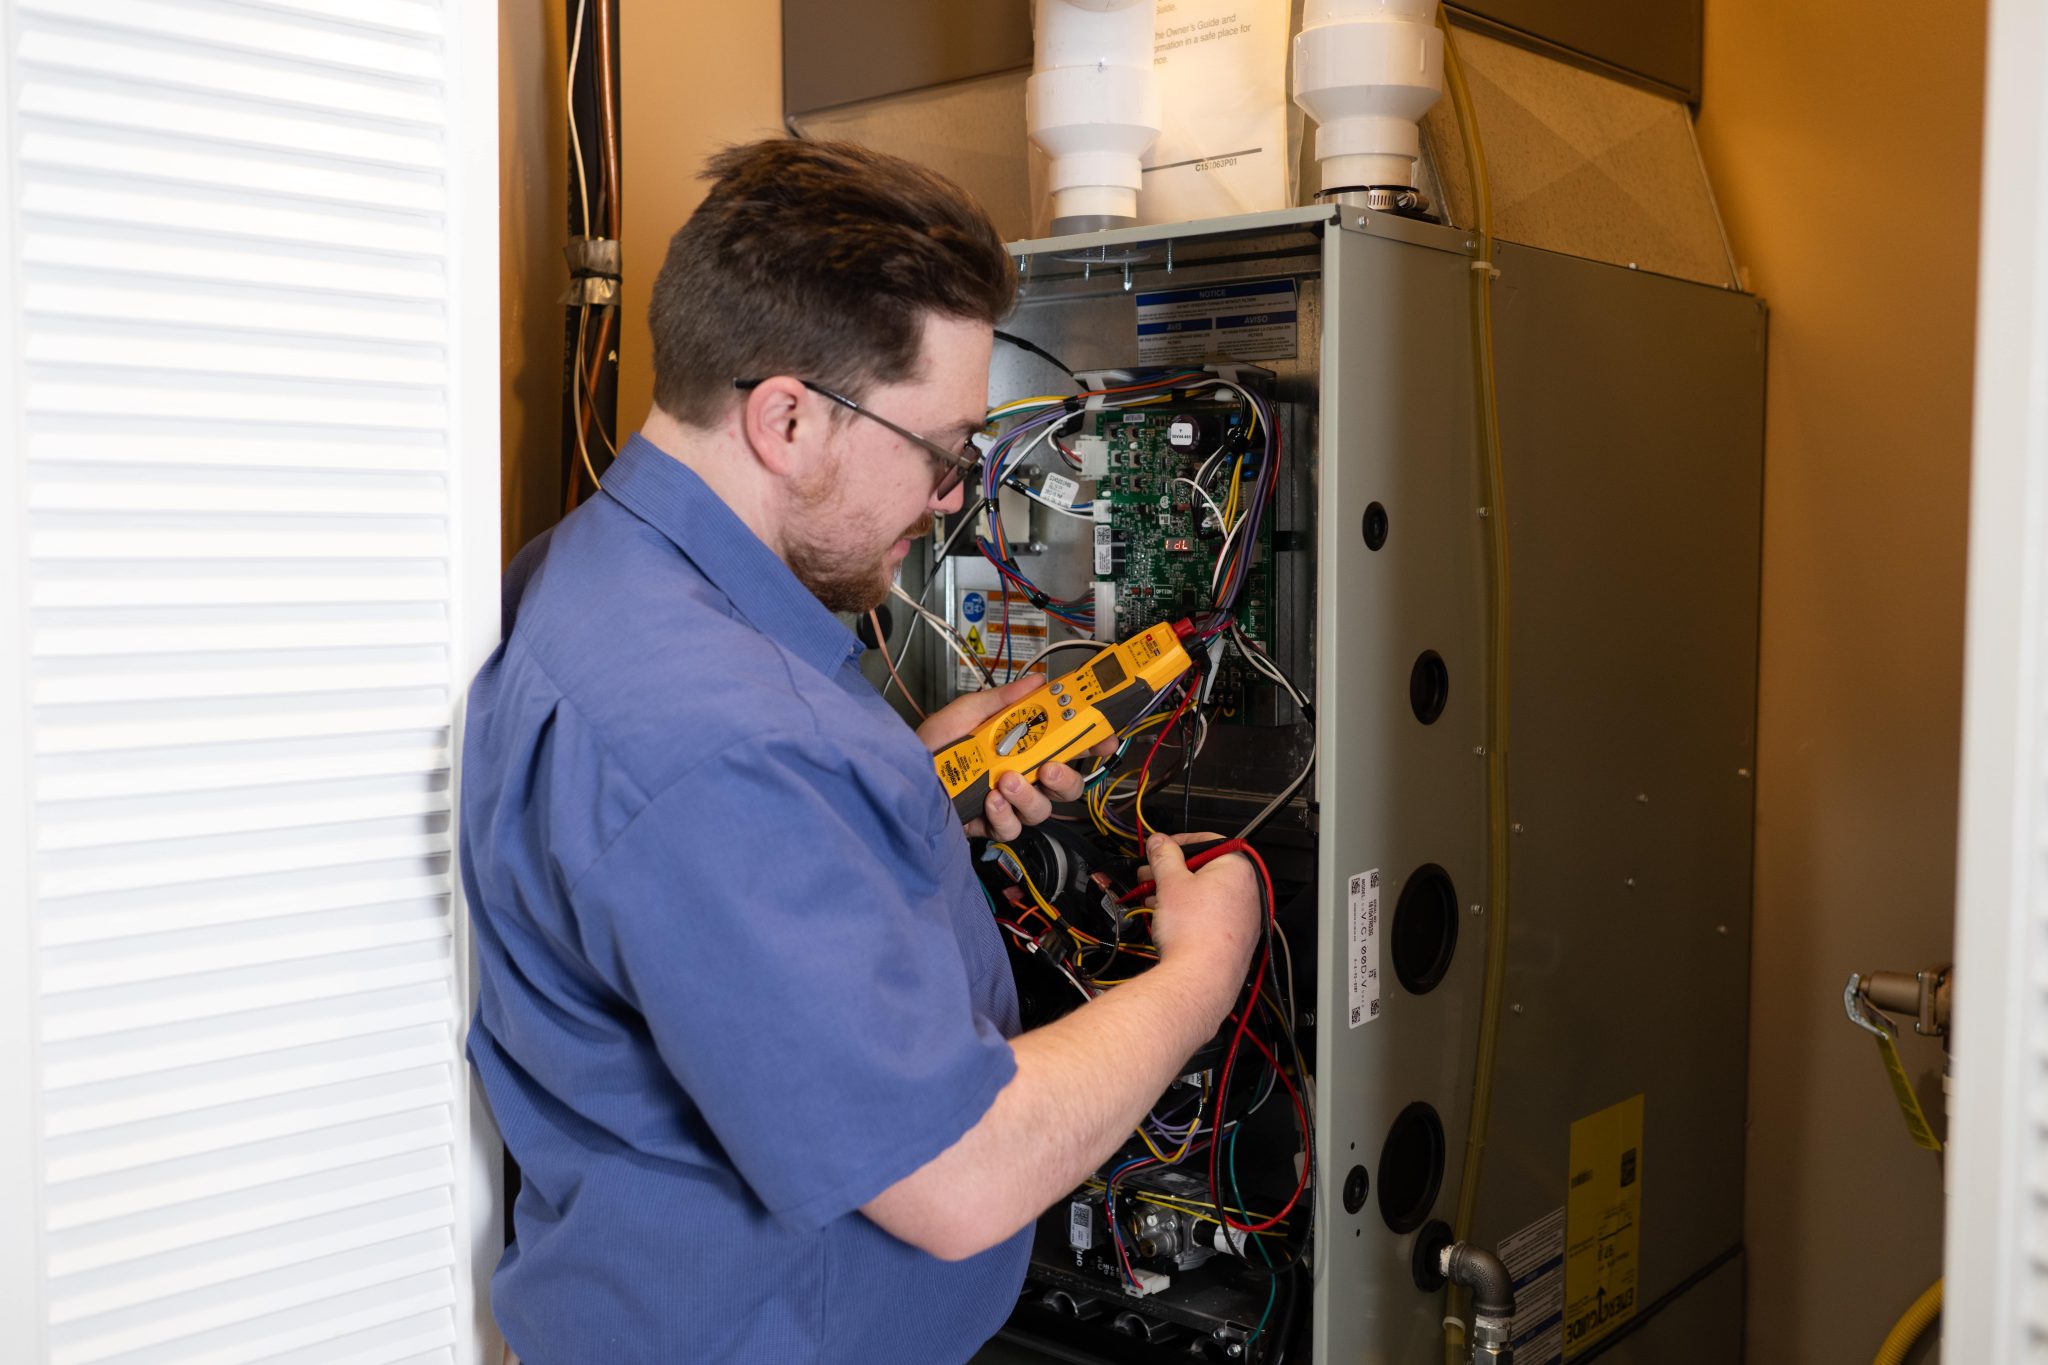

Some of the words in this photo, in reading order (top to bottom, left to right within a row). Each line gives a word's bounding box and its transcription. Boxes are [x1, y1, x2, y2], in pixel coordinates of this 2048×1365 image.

[1166, 24, 1196, 38] Owner's
[1197, 18, 1219, 30] Guide
[1222, 13, 1237, 25] and
[1185, 36, 1192, 46] in
[1200, 30, 1216, 42] safe
[1218, 26, 1239, 40] place
[1240, 23, 1252, 34] for
[1199, 287, 1226, 299] NOTICE
[1243, 315, 1268, 324] AVISO
